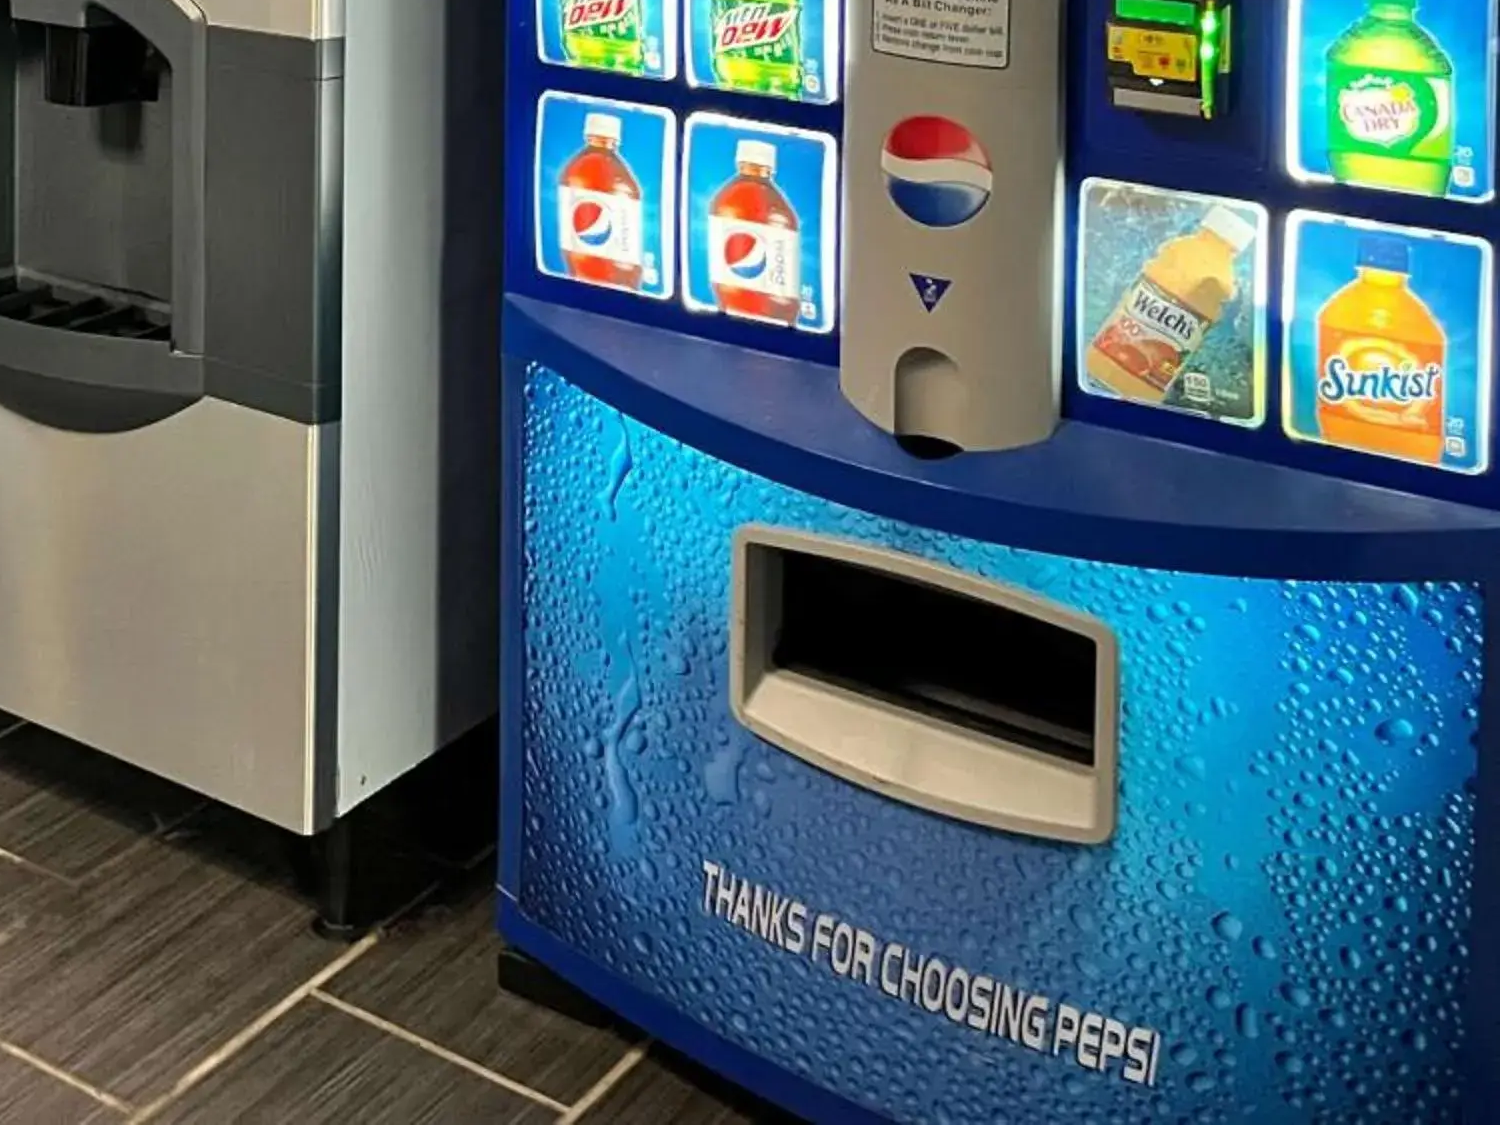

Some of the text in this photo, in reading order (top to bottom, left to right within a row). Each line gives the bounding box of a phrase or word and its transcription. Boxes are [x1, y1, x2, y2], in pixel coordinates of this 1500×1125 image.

[1363, 115, 1401, 133] DRY
[1133, 289, 1195, 341] Welch's
[1319, 357, 1441, 402] Sunkist
[702, 859, 1161, 1088] THANKS FOR CHOOSING PEPSI
